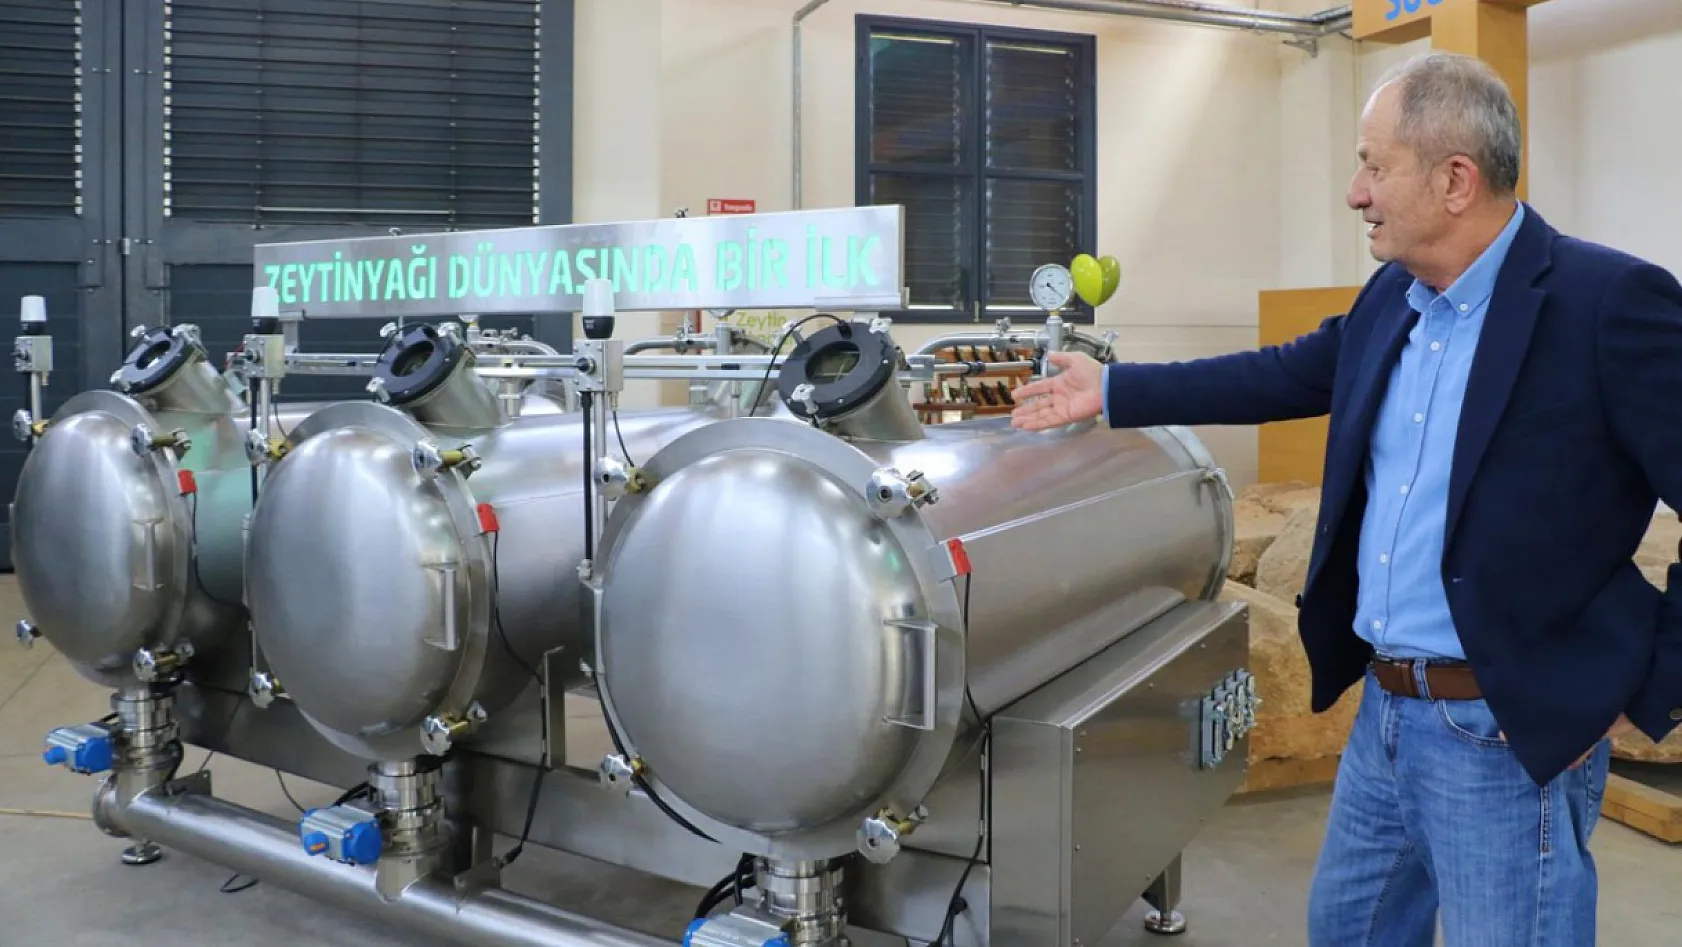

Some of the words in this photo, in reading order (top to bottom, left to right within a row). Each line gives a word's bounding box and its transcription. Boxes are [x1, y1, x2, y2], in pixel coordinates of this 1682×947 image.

[263, 243, 437, 304] ZEYTİNYAĞI
[449, 241, 698, 298] DÜNYASINDA
[715, 226, 790, 291] BİR
[806, 223, 881, 290] İLK
